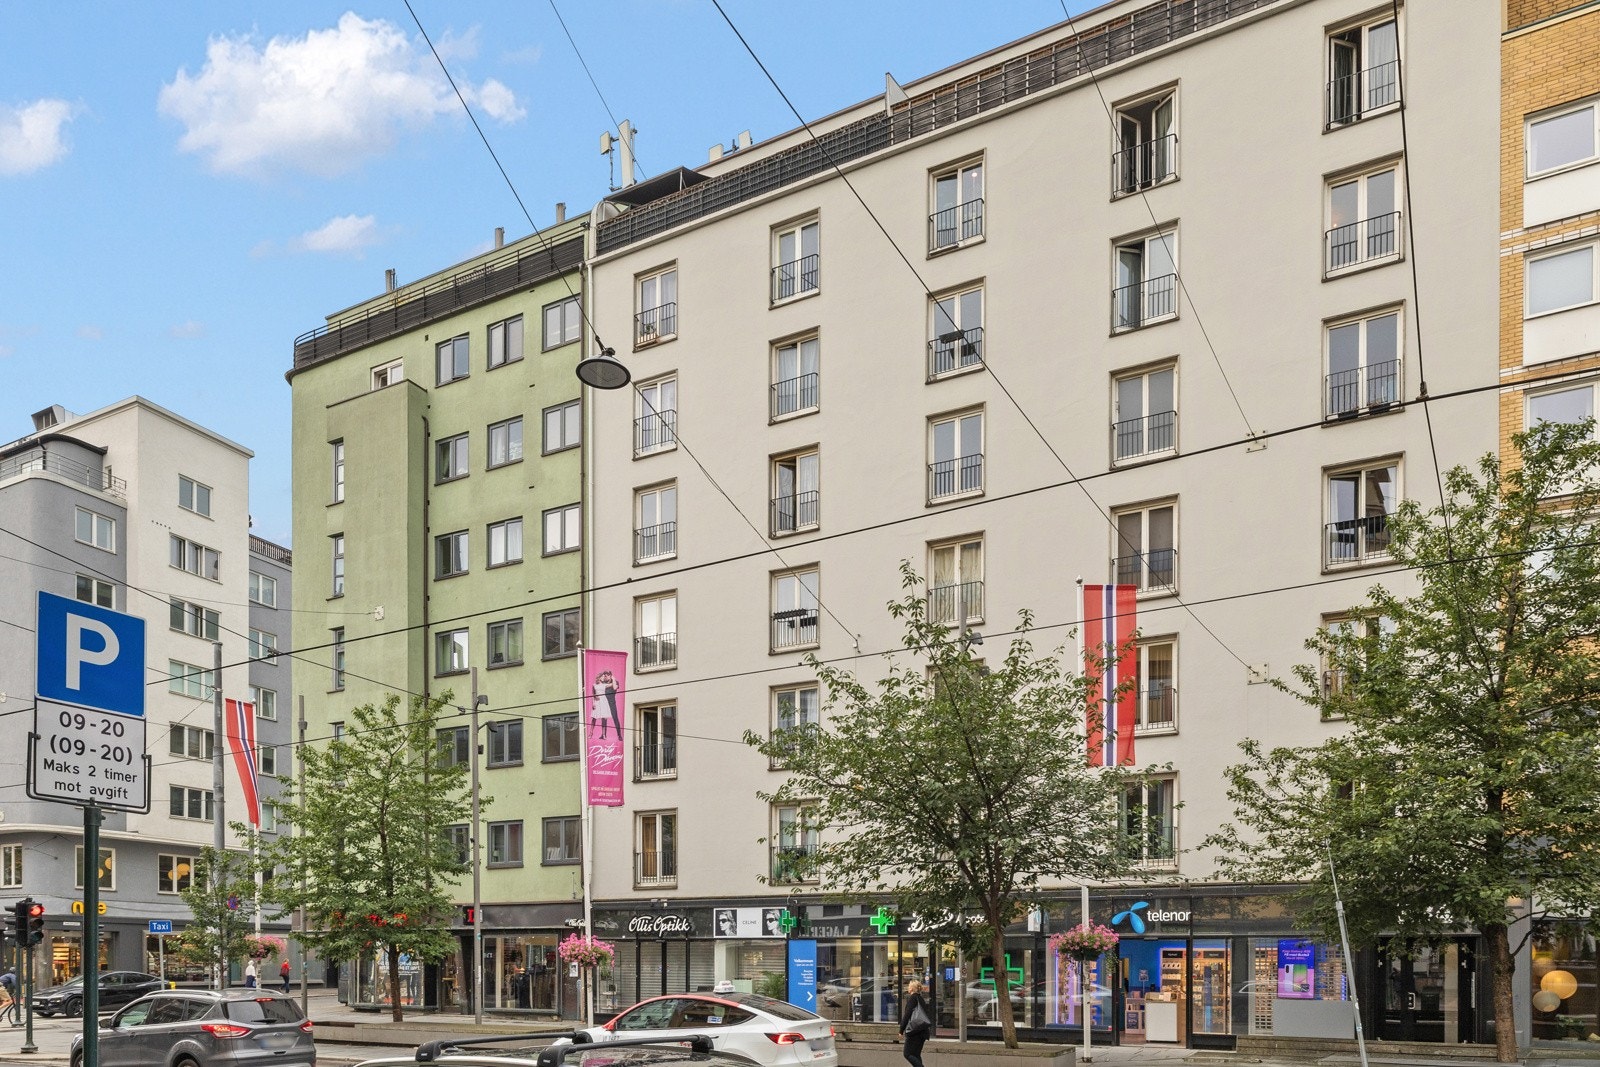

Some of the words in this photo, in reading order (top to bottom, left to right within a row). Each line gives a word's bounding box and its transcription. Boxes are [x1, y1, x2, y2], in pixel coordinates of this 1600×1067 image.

[66, 612, 120, 691] P
[59, 711, 125, 738] 09-20
[50, 734, 133, 766] (09-20)
[43, 758, 80, 775] Maks
[88, 765, 96, 777] 2
[104, 768, 138, 783] timer
[54, 781, 81, 793] mot
[89, 785, 128, 800] avgift
[152, 922, 169, 930] Taxi
[628, 916, 653, 932] Ollis
[653, 916, 690, 935] Optikk
[1146, 909, 1191, 921] telenor
